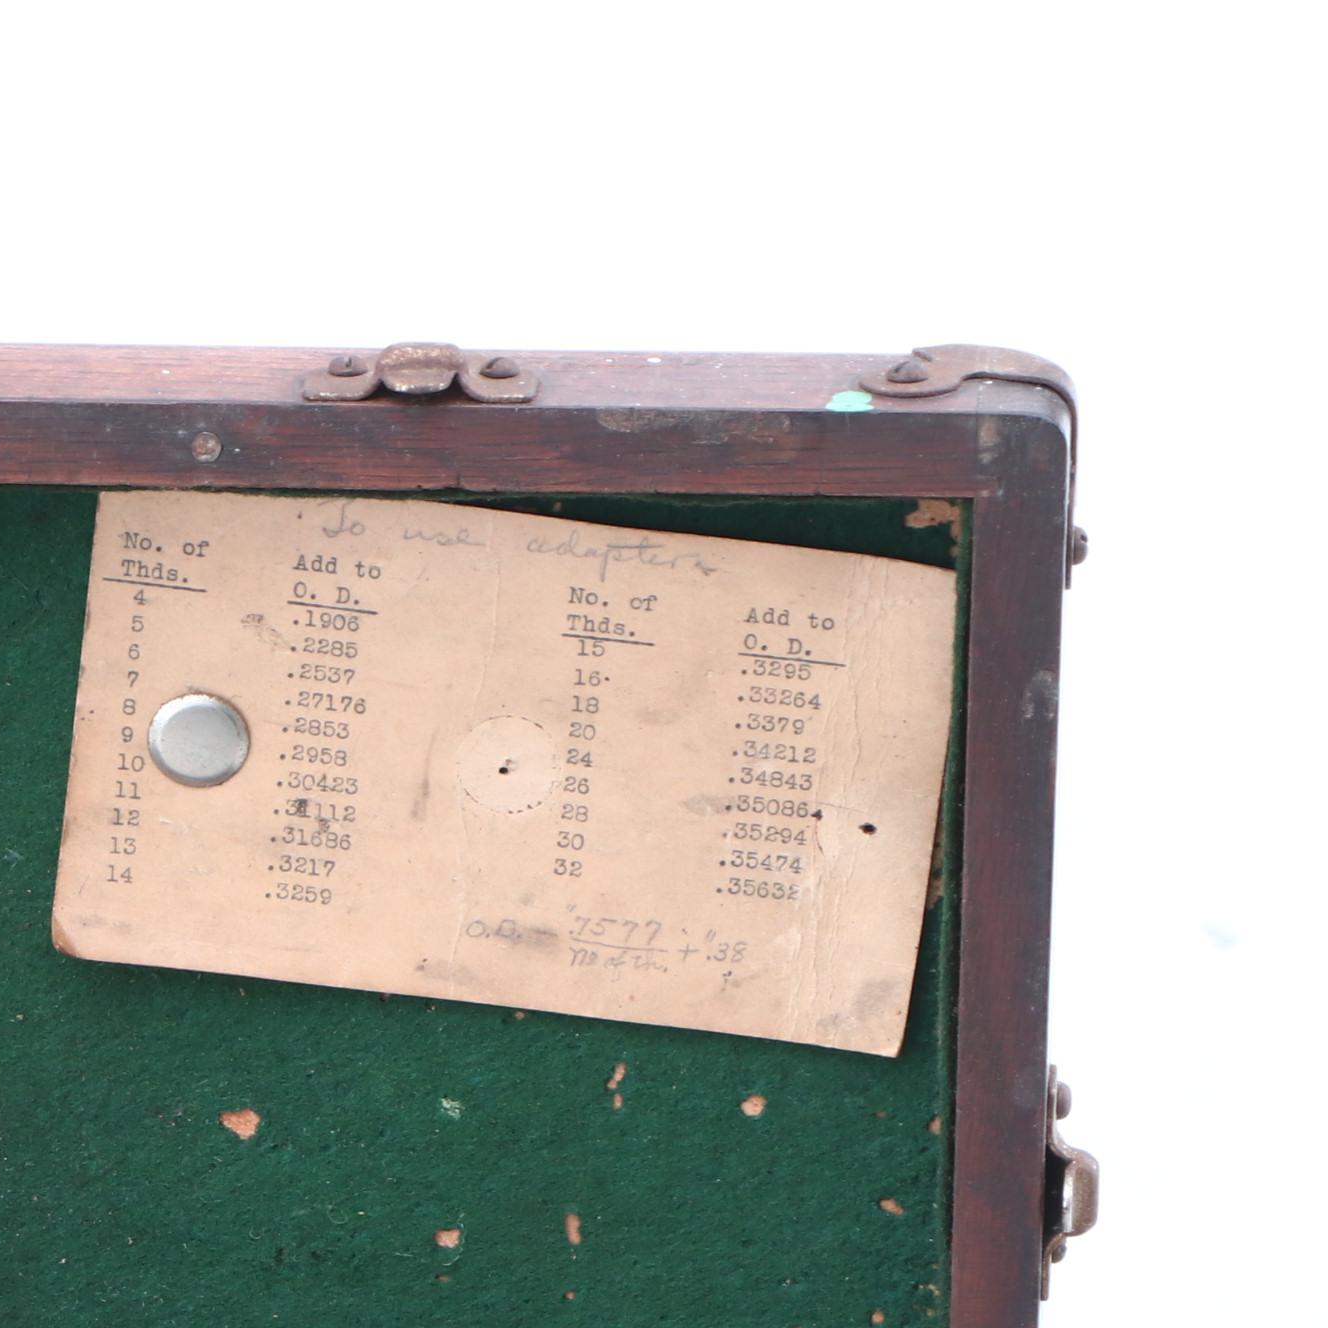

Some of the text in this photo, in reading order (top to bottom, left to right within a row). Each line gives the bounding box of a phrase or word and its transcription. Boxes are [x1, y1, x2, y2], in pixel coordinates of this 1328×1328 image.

[122, 531, 210, 558] No. of
[401, 526, 488, 548] use
[120, 560, 189, 583] Thds.
[292, 554, 381, 580] Add to
[133, 589, 360, 632] 4 .1906
[292, 582, 360, 604] O. D.
[568, 586, 658, 612] No. of
[131, 615, 358, 659] 5 .2285
[566, 614, 637, 637] Thds.
[743, 607, 835, 631] Add to
[128, 643, 356, 685] 6 .2537
[576, 640, 812, 680] 15 .3295
[743, 633, 812, 656] O. D.
[126, 670, 366, 715] 7 .27176
[573, 668, 822, 710] 16 .33264
[122, 698, 350, 740] 8 .2853
[571, 695, 805, 735] 18 .3379
[121, 726, 348, 767] 9 .2958
[569, 722, 816, 764] 20 .34212
[115, 780, 141, 800] 11
[117, 753, 358, 795] 10 .30423
[566, 748, 813, 791] 24 .34843
[563, 776, 809, 818] 26 .35086
[109, 807, 352, 850] 12 .31686
[560, 803, 810, 846] 28 .35294
[110, 836, 336, 877] 13 .3217
[556, 831, 803, 874] 30 .35474
[106, 864, 332, 905] 14 .3259
[553, 858, 798, 900] 32 .35632
